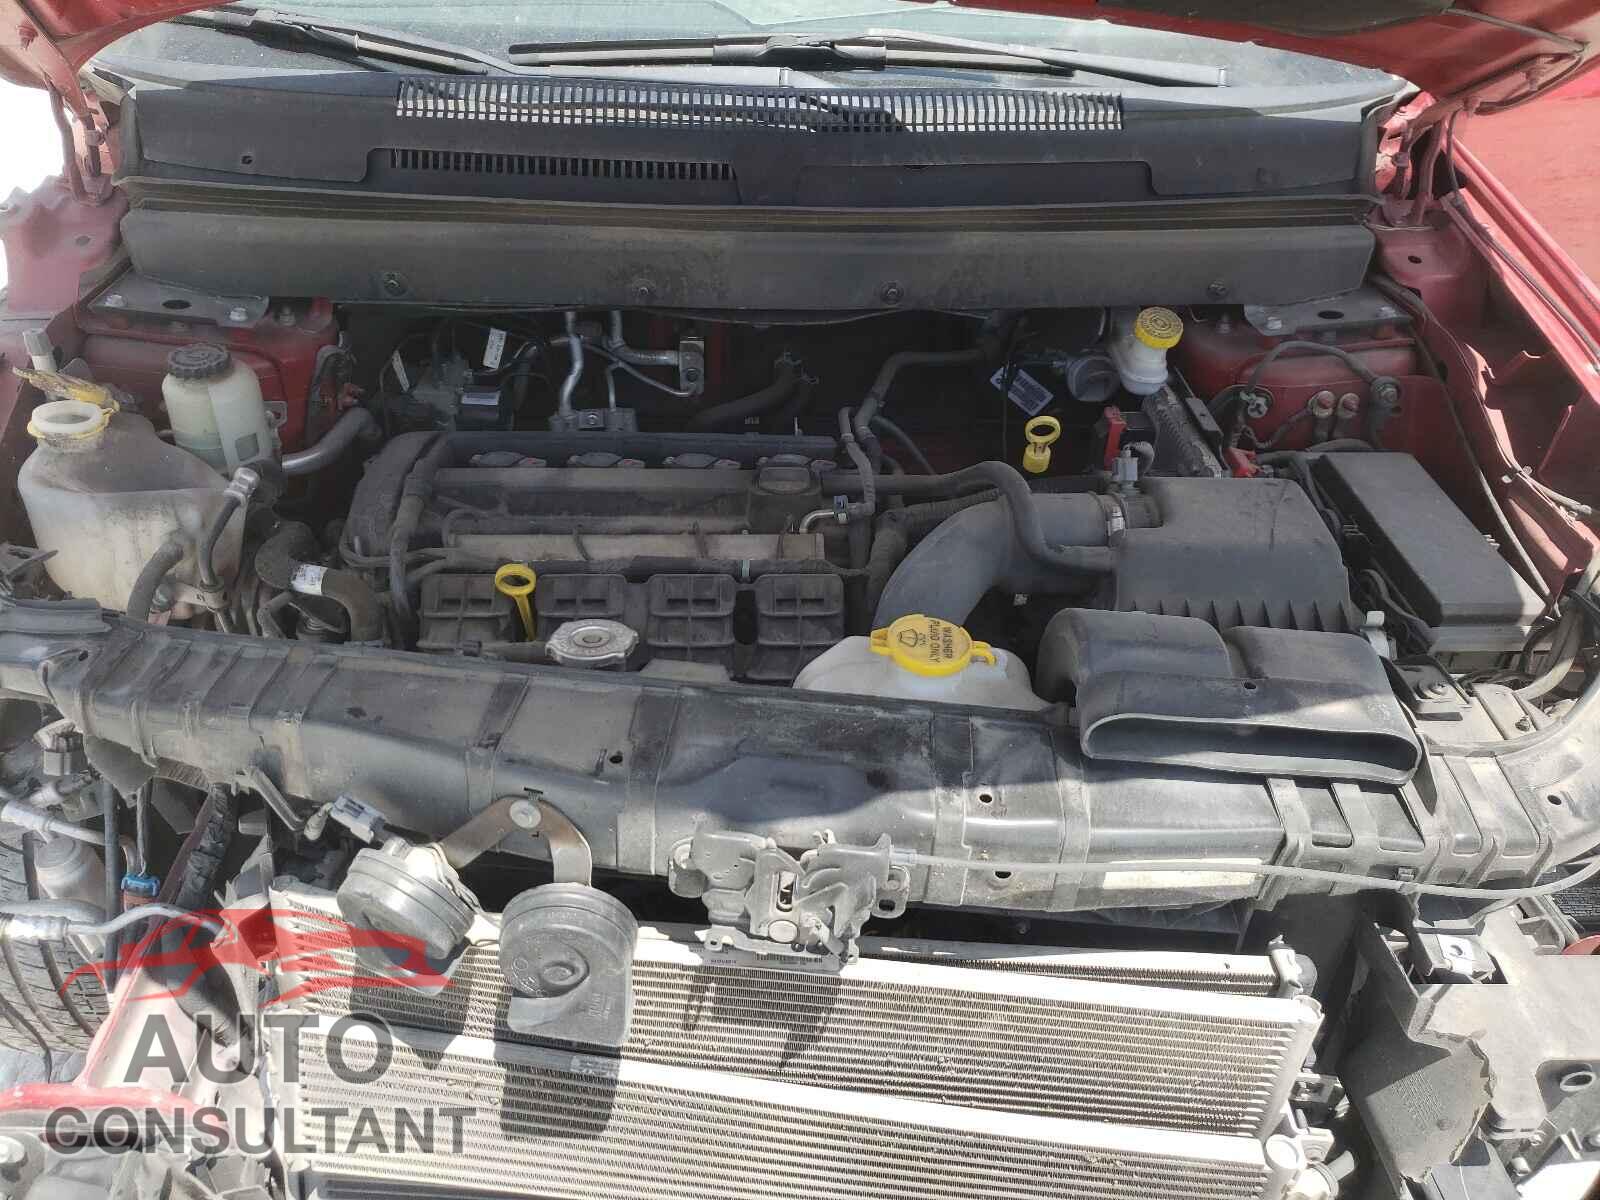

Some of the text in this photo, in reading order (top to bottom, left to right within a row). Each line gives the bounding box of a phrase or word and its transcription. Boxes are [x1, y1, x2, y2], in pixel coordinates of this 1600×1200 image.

[929, 619, 940, 663] FLUID ONLY
[942, 626, 953, 659] WASHER
